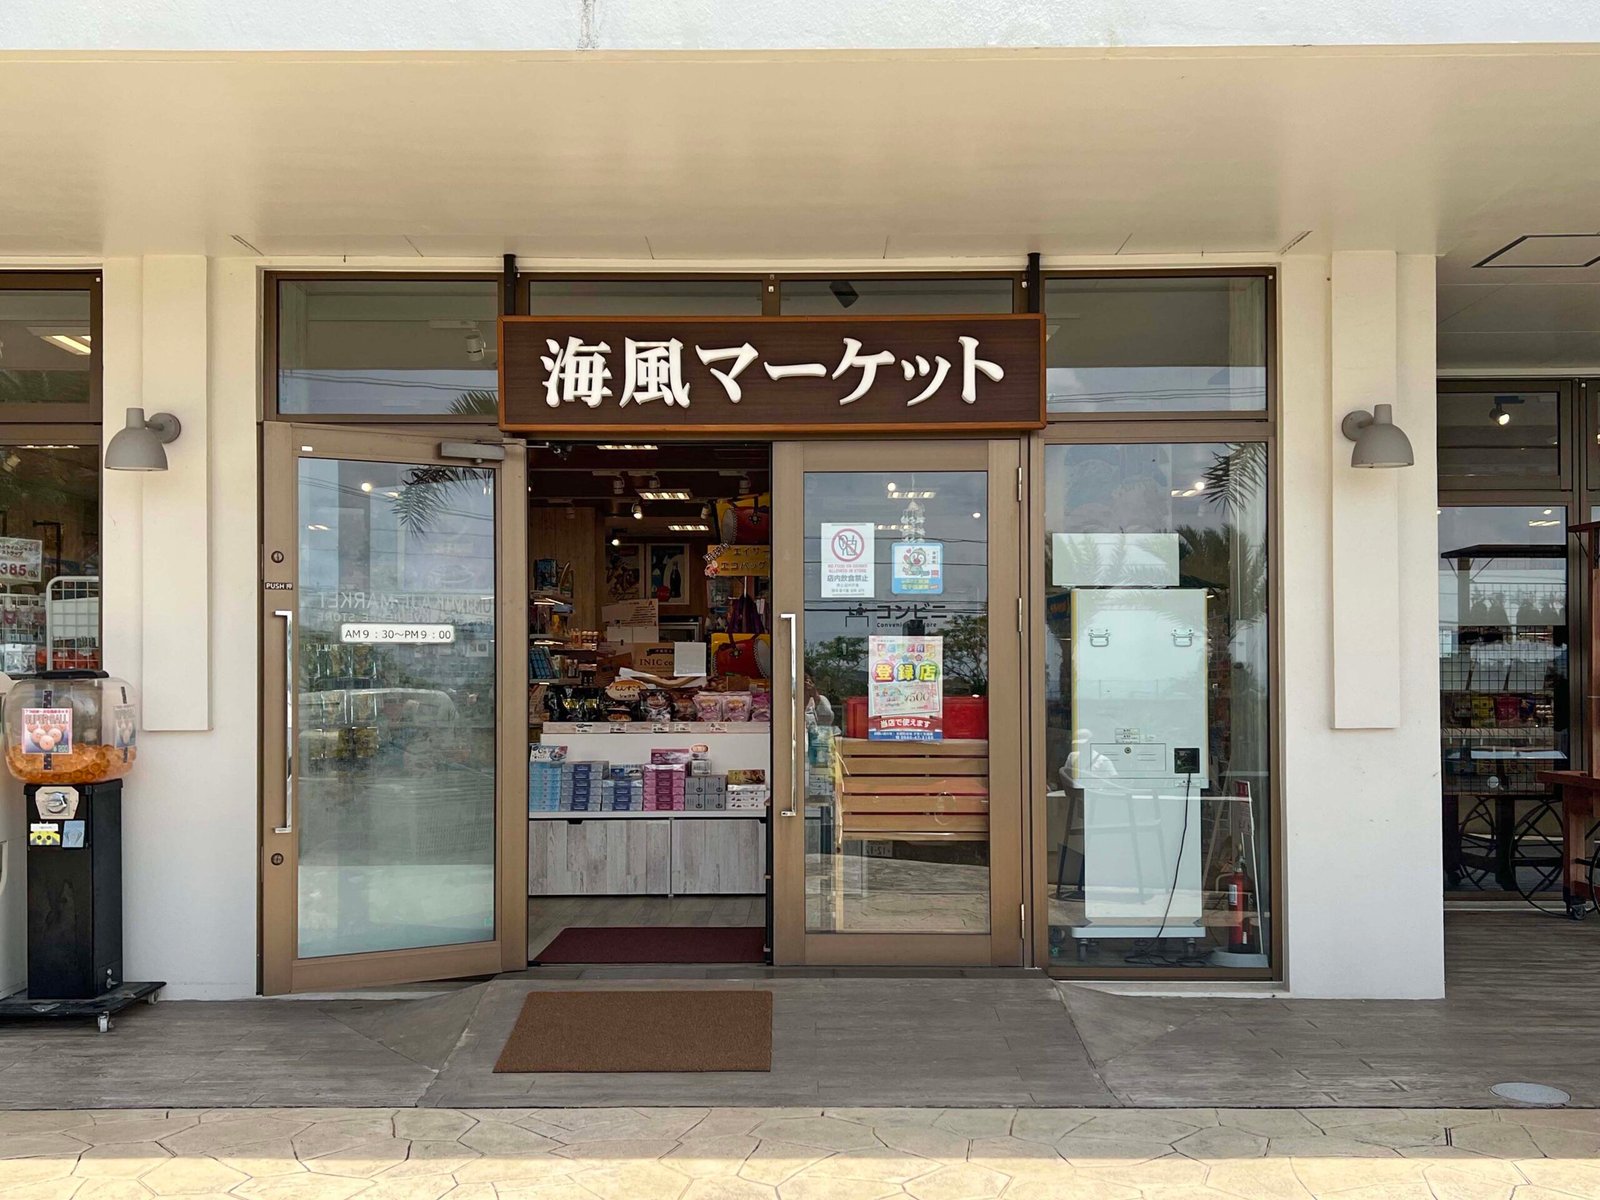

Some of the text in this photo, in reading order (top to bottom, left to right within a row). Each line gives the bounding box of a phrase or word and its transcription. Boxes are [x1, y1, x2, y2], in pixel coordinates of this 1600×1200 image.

[540, 335, 1005, 409] 海風マーケット
[827, 574, 869, 582] 店内飲食禁止
[877, 602, 947, 620] コンビニ
[640, 658, 663, 666] INIC
[875, 663, 938, 682] 登録店
[880, 718, 932, 729] 当店で使えます
